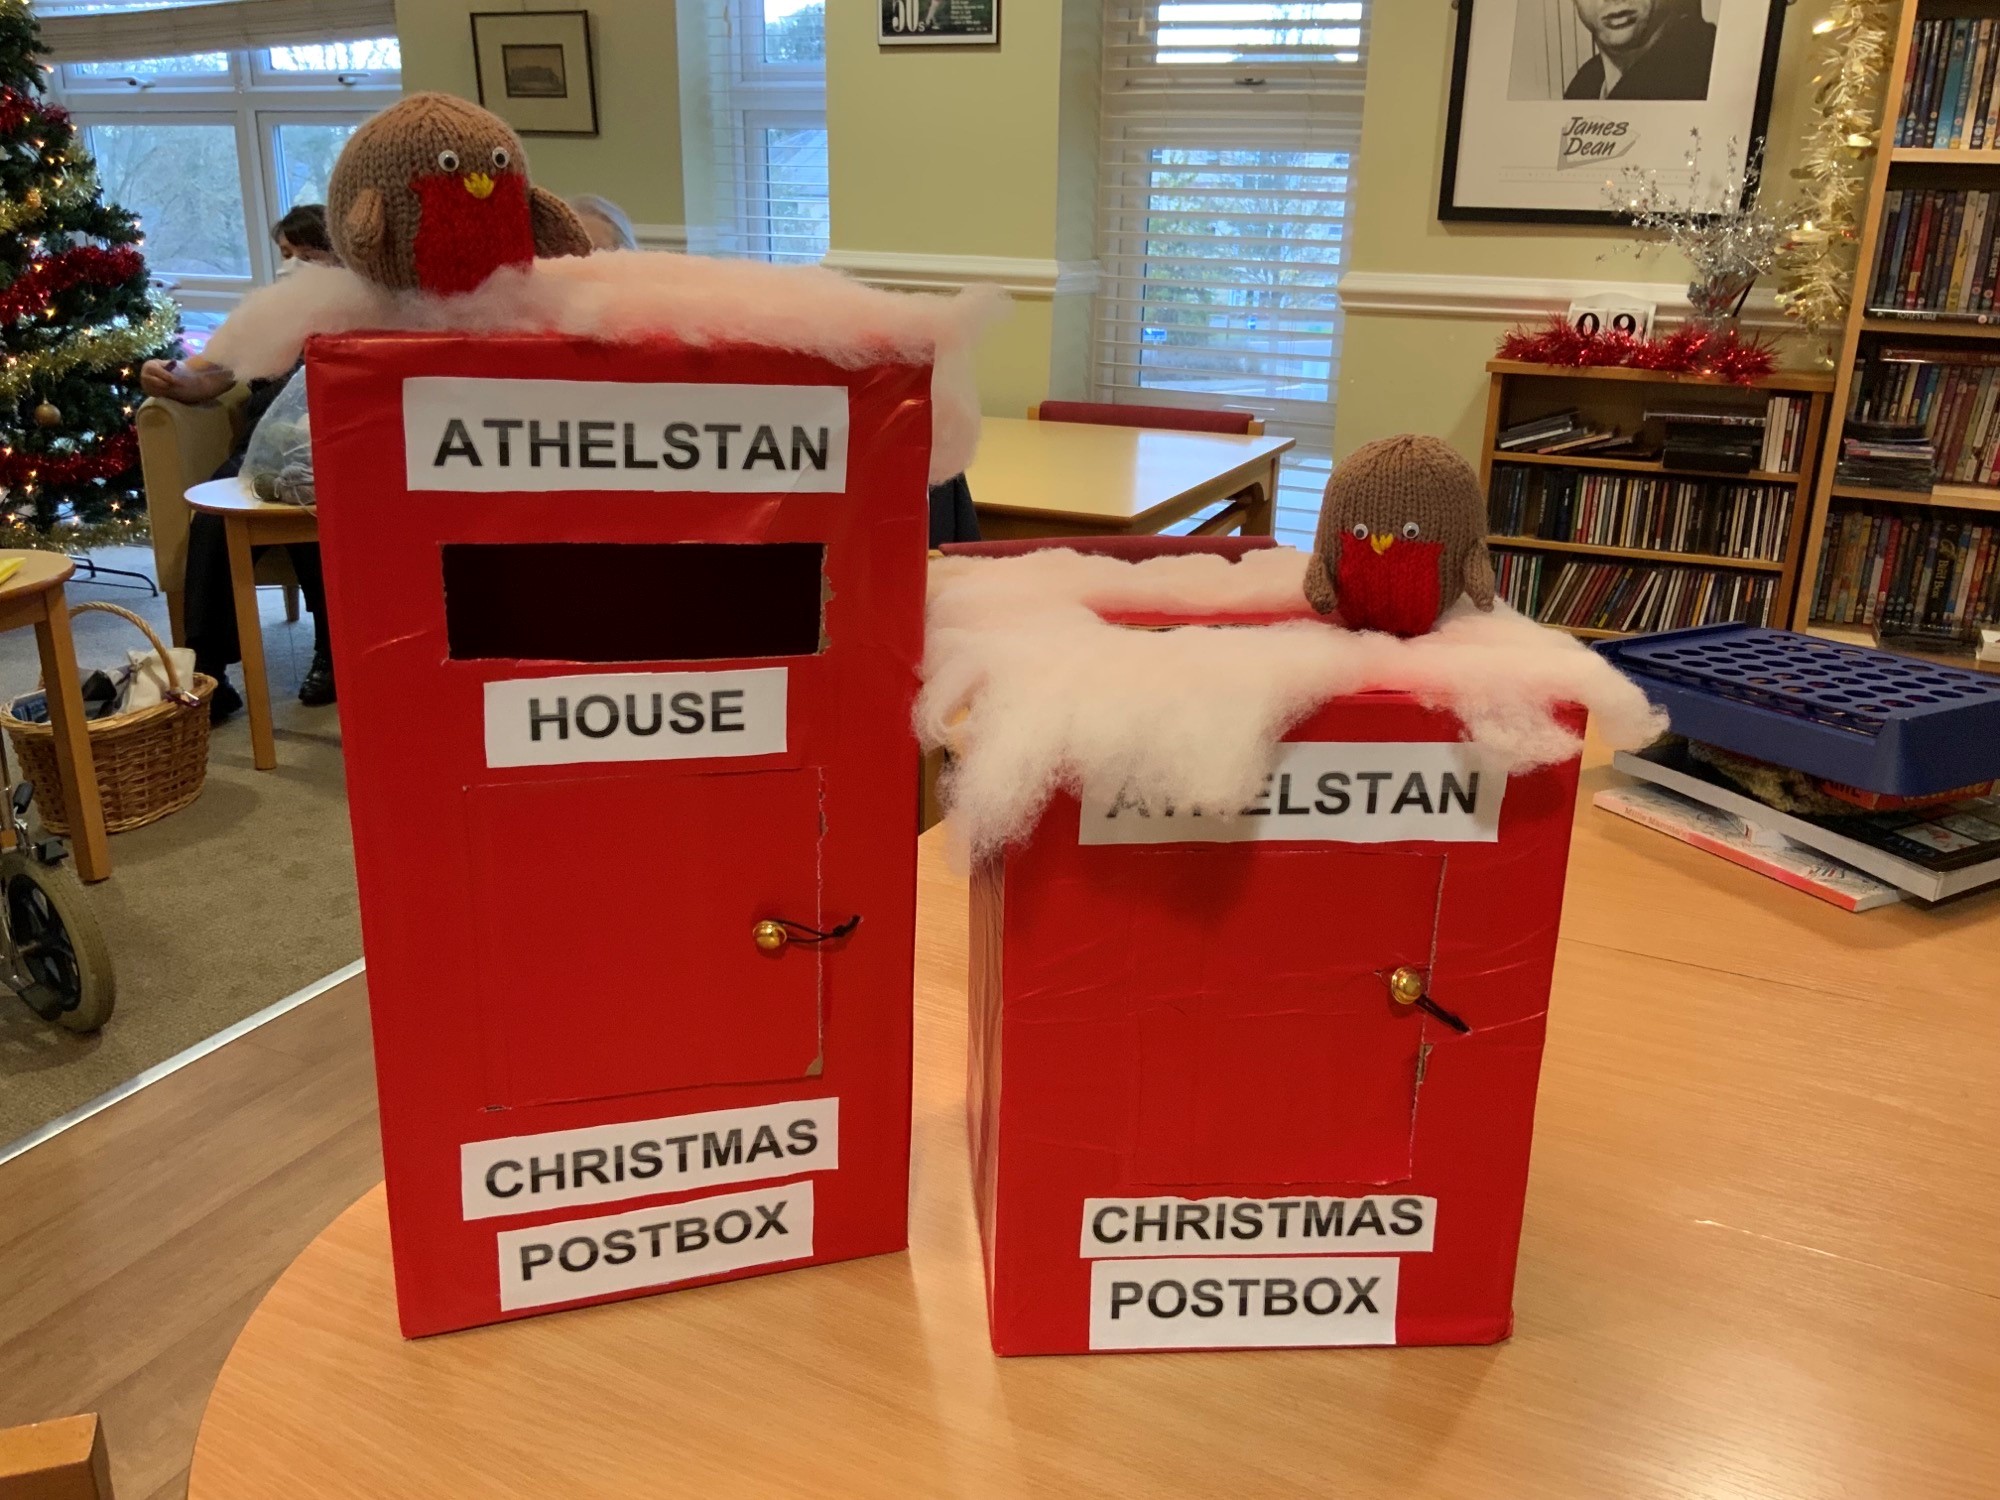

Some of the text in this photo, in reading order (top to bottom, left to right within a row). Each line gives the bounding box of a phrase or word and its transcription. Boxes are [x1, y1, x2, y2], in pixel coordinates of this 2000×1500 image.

[1562, 117, 1629, 136] James
[1564, 138, 1616, 156] Dean
[432, 419, 829, 471] ATHELSTAN
[528, 690, 745, 741] HOUSE
[1106, 771, 1479, 818] AELSTAN
[485, 1118, 818, 1198] CHRISTMAS
[520, 1201, 789, 1281] POSTBOX
[1092, 1197, 1424, 1244] CHRISTMAS
[1110, 1276, 1381, 1320] POSTBOX
